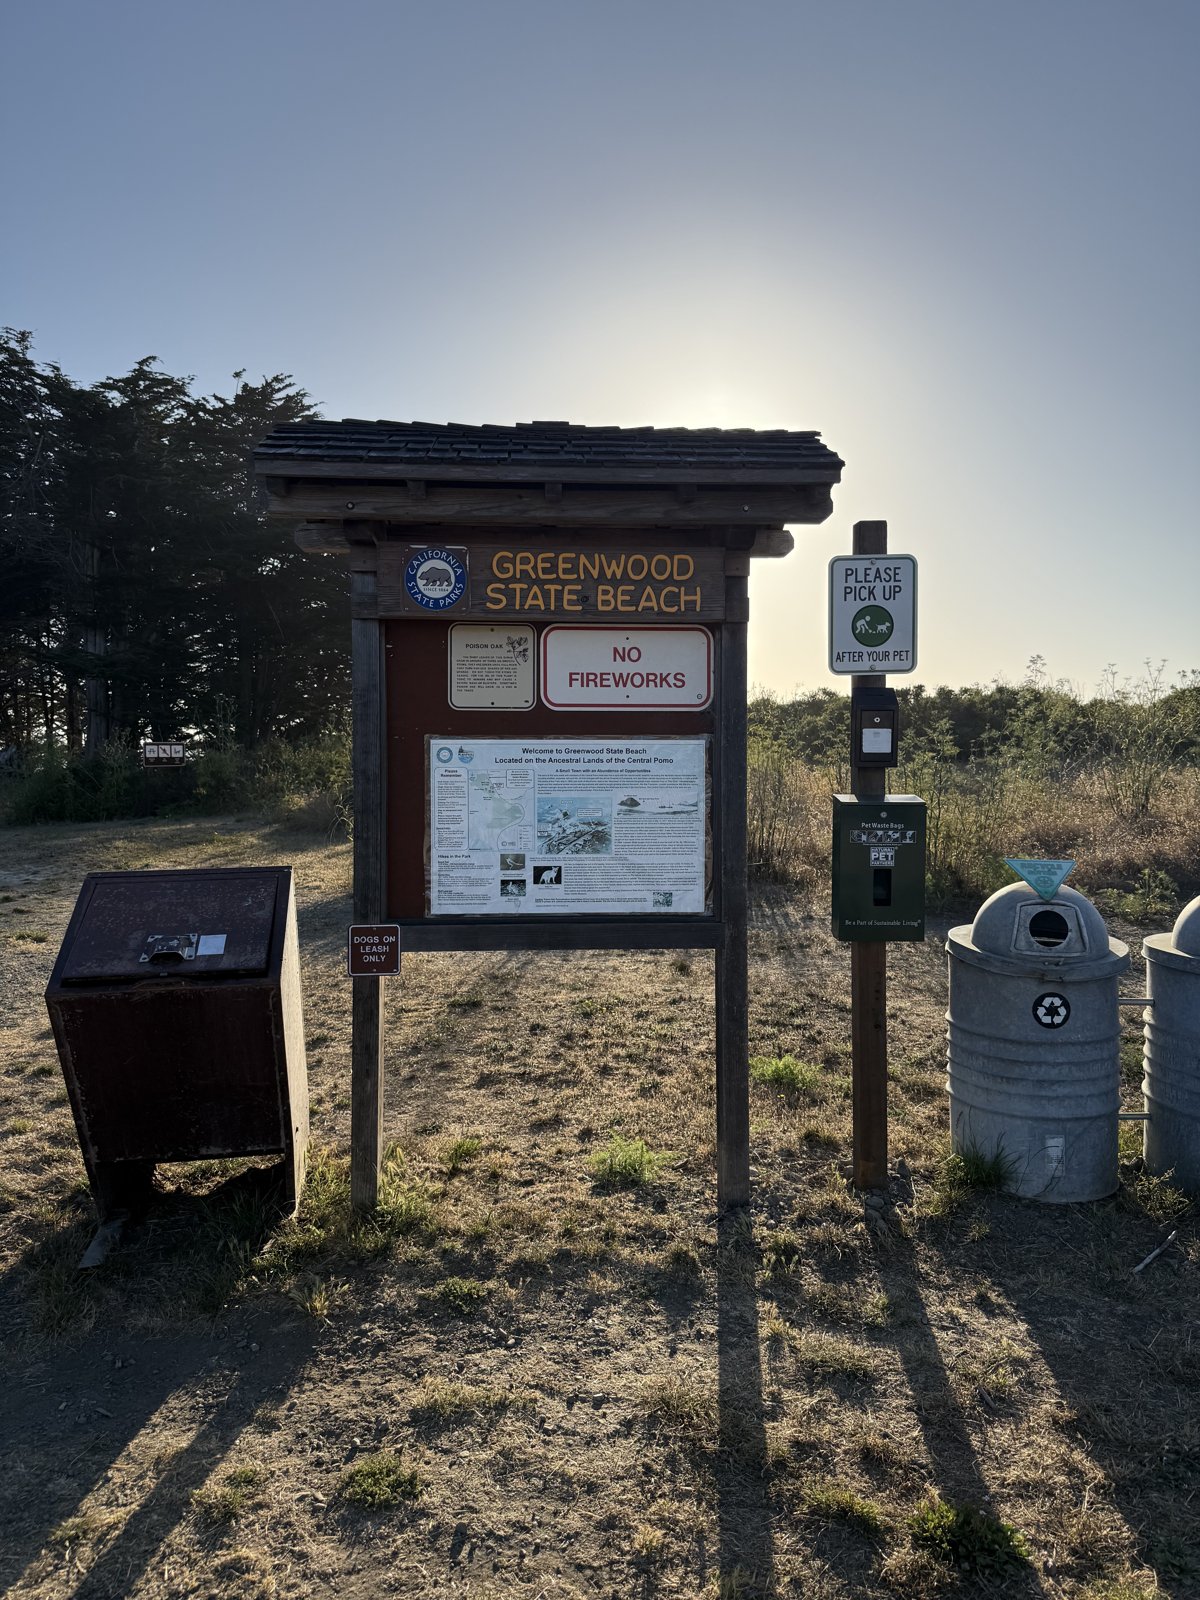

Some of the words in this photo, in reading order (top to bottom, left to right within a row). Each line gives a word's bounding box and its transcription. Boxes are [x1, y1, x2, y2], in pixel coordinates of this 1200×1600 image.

[408, 550, 463, 576] CALIFORNIA
[492, 551, 695, 581] GREENWOOD
[844, 567, 901, 583] PLEASE
[407, 581, 435, 608] STATE
[439, 582, 464, 607] PARKS
[485, 583, 583, 611] STATE
[597, 585, 701, 613] BEACH
[843, 585, 877, 602] PICK
[882, 584, 903, 601] UP
[612, 646, 642, 663] NO
[835, 651, 864, 663] AFTER
[866, 650, 891, 662] YOUR
[892, 649, 910, 662] PET
[568, 672, 686, 688] FIREWORKS
[522, 747, 555, 755] Welcome
[555, 747, 563, 755] to
[564, 747, 604, 755] Greenwood
[605, 747, 624, 755] State
[625, 747, 647, 755] Beach
[890, 822, 905, 830] Bags
[871, 852, 894, 861] PET
